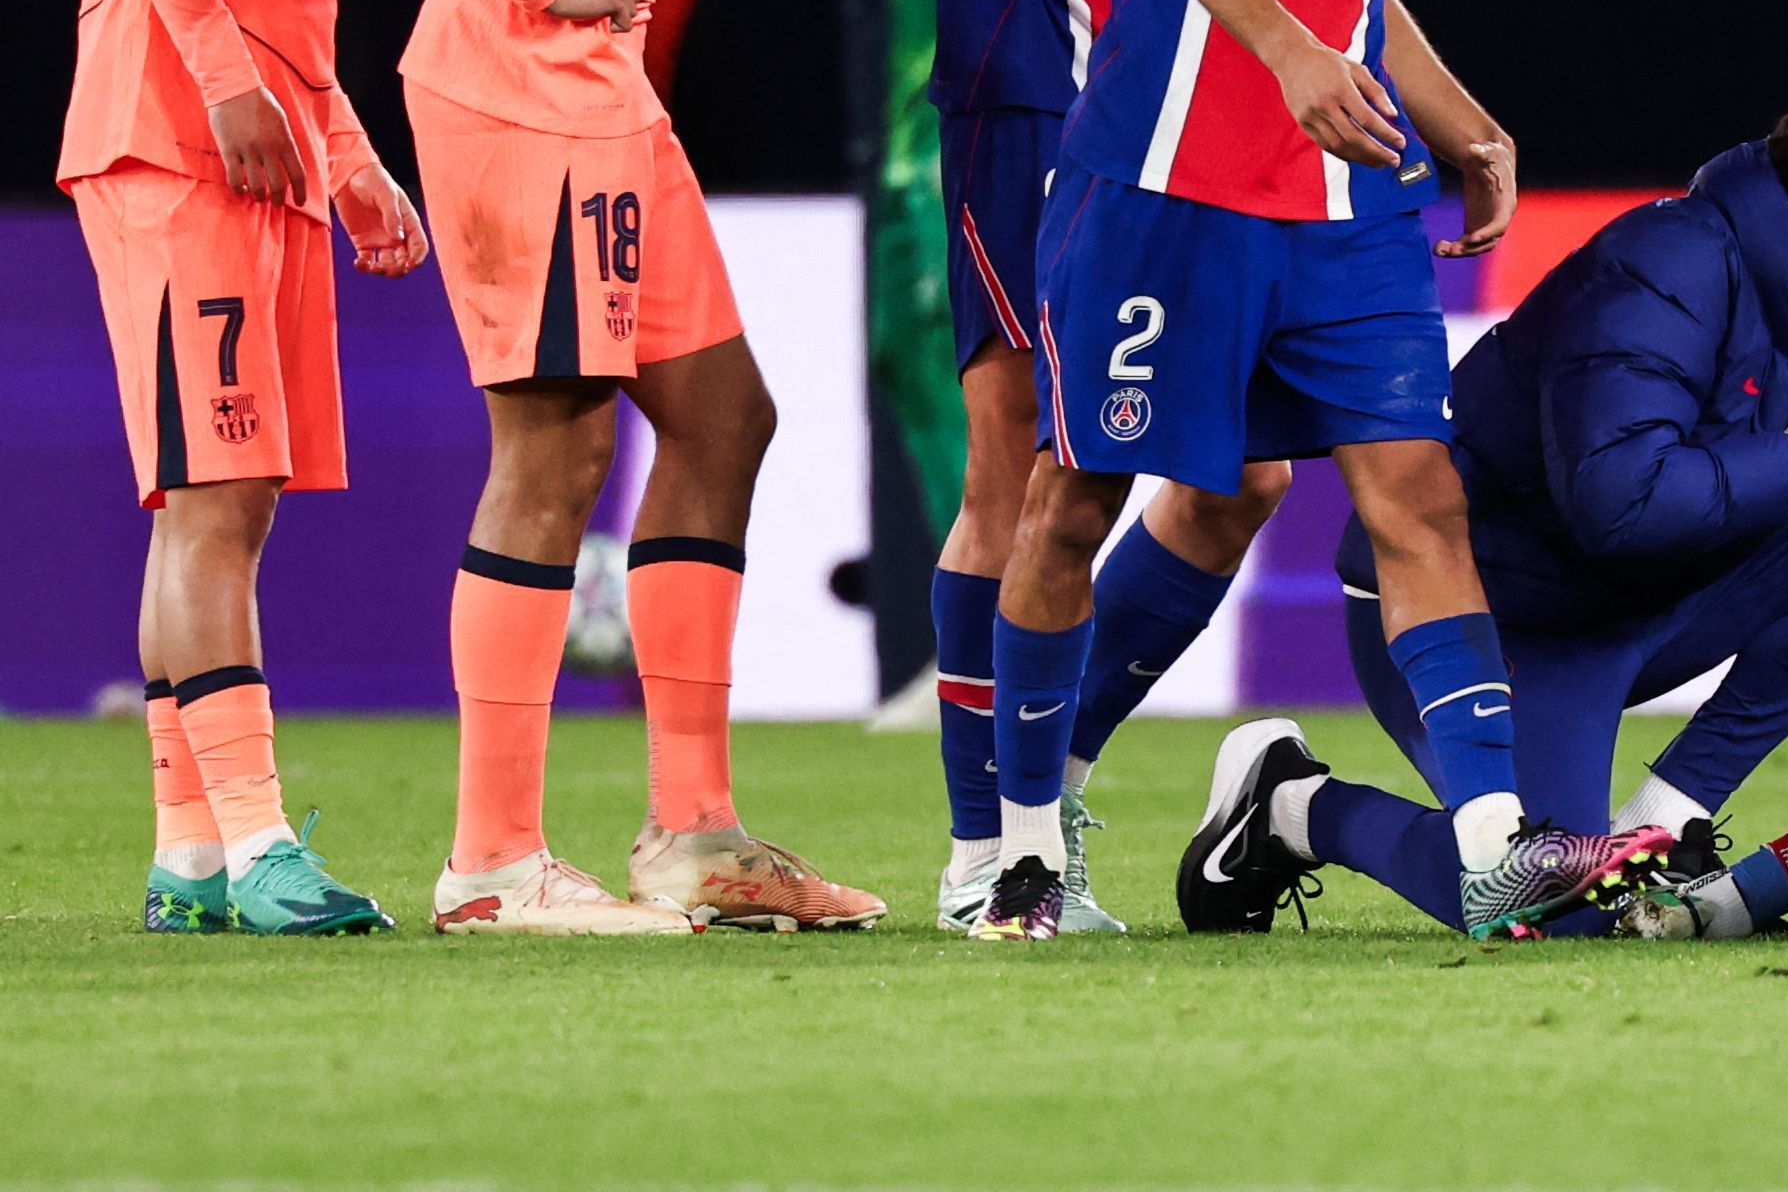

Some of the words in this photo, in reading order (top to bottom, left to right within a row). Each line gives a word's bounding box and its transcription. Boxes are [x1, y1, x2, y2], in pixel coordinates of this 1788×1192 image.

[581, 191, 640, 283] 18
[197, 296, 244, 387] 7
[1108, 295, 1165, 380] 2
[1111, 389, 1143, 403] PARIS
